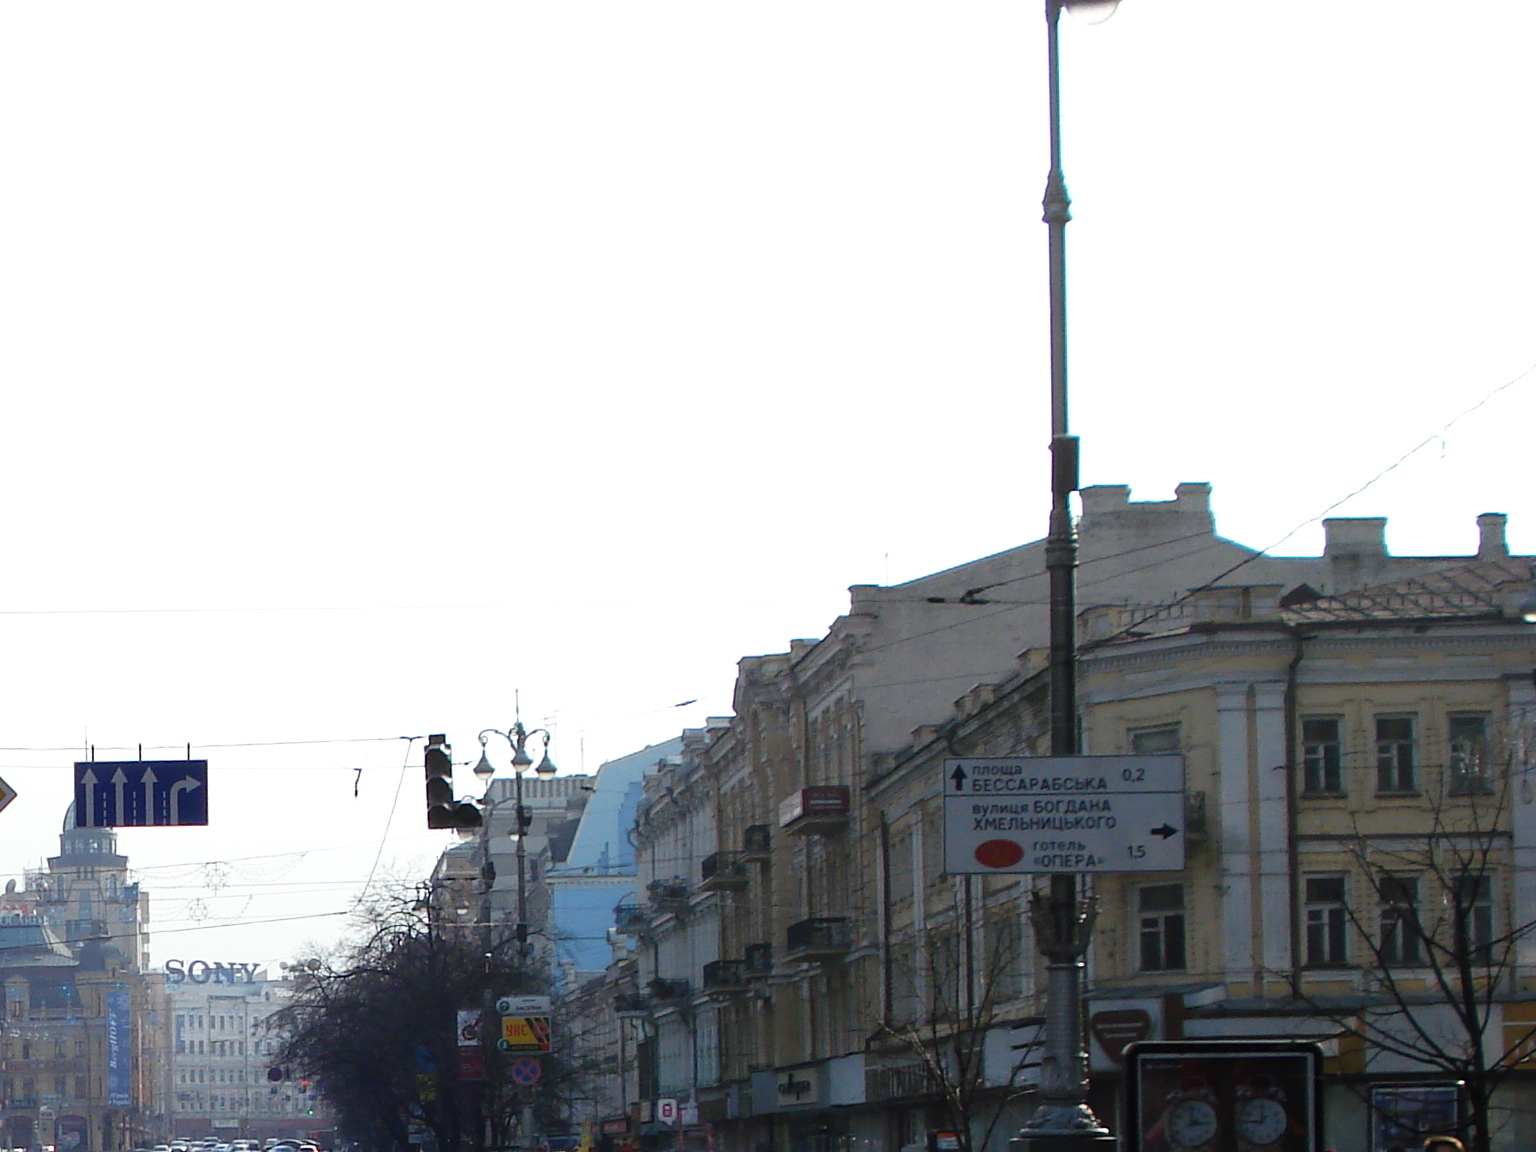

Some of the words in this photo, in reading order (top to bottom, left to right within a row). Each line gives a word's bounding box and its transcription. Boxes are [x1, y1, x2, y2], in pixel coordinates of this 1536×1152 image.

[971, 764, 1023, 777] площа
[971, 777, 1108, 793] БЕССАРАБСЬКА
[971, 804, 1029, 817] вулиця
[1033, 800, 1112, 815] БОГДАНА
[972, 816, 1117, 831] ХМЕЛЬНИЦЬКОГО
[1033, 840, 1087, 851] готель
[165, 959, 261, 985] SONY
